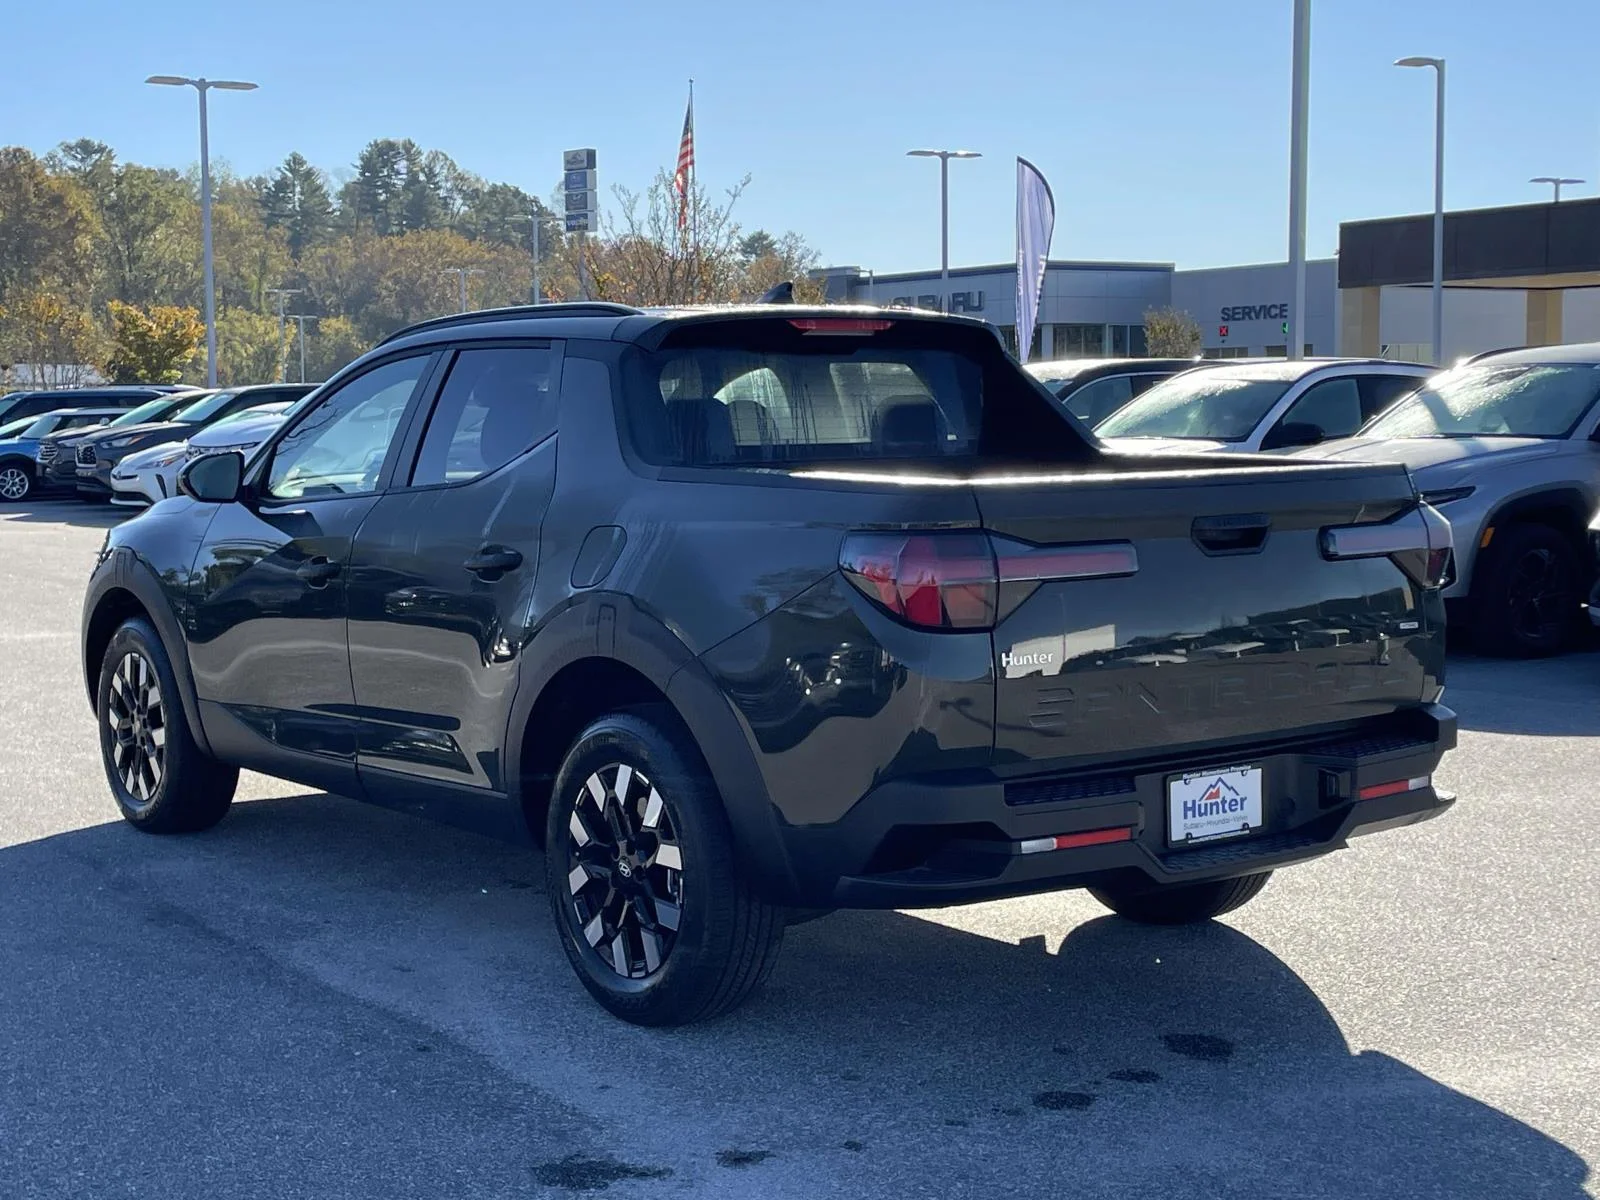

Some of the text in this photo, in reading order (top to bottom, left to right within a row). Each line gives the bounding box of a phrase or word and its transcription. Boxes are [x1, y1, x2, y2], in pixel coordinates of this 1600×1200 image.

[1221, 303, 1288, 321] SERVICE
[1002, 652, 1054, 668] Hunter
[1183, 796, 1247, 820] Hunter
